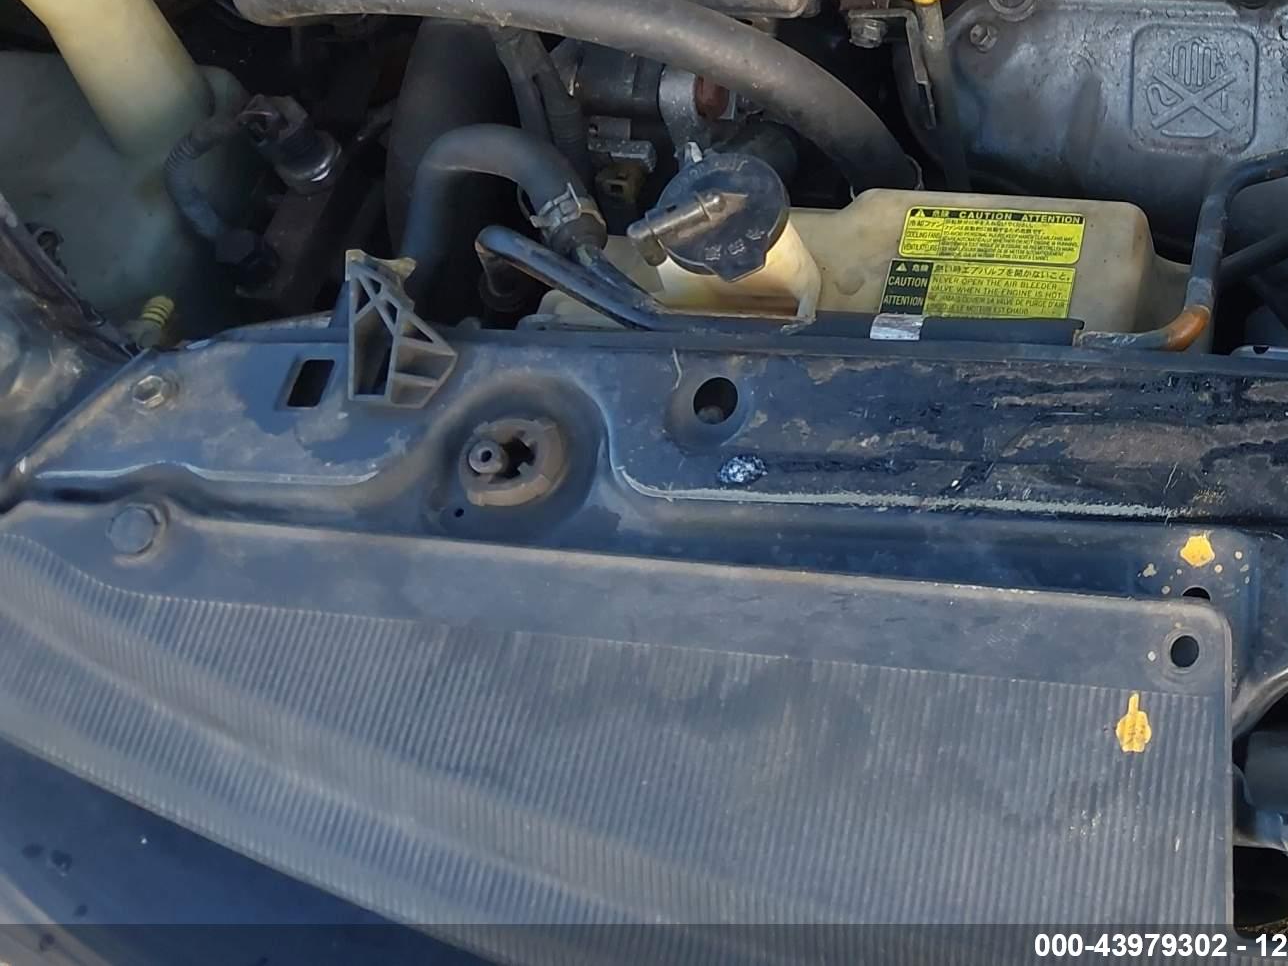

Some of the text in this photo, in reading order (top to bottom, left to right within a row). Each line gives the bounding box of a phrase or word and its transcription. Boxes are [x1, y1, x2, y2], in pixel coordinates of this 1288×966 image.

[959, 211, 1012, 220] CAUTION
[1021, 214, 1080, 223] ATTENTION
[888, 276, 928, 287] CAUTION
[932, 275, 960, 284] NEVER
[961, 278, 983, 286] OPEN
[1020, 282, 1057, 290] BLEEDER
[931, 284, 954, 292] VALVE
[957, 286, 980, 294] WHEN
[984, 287, 998, 295] THE
[1002, 289, 1032, 297] ENGINE
[883, 295, 923, 306] ATTENTION
